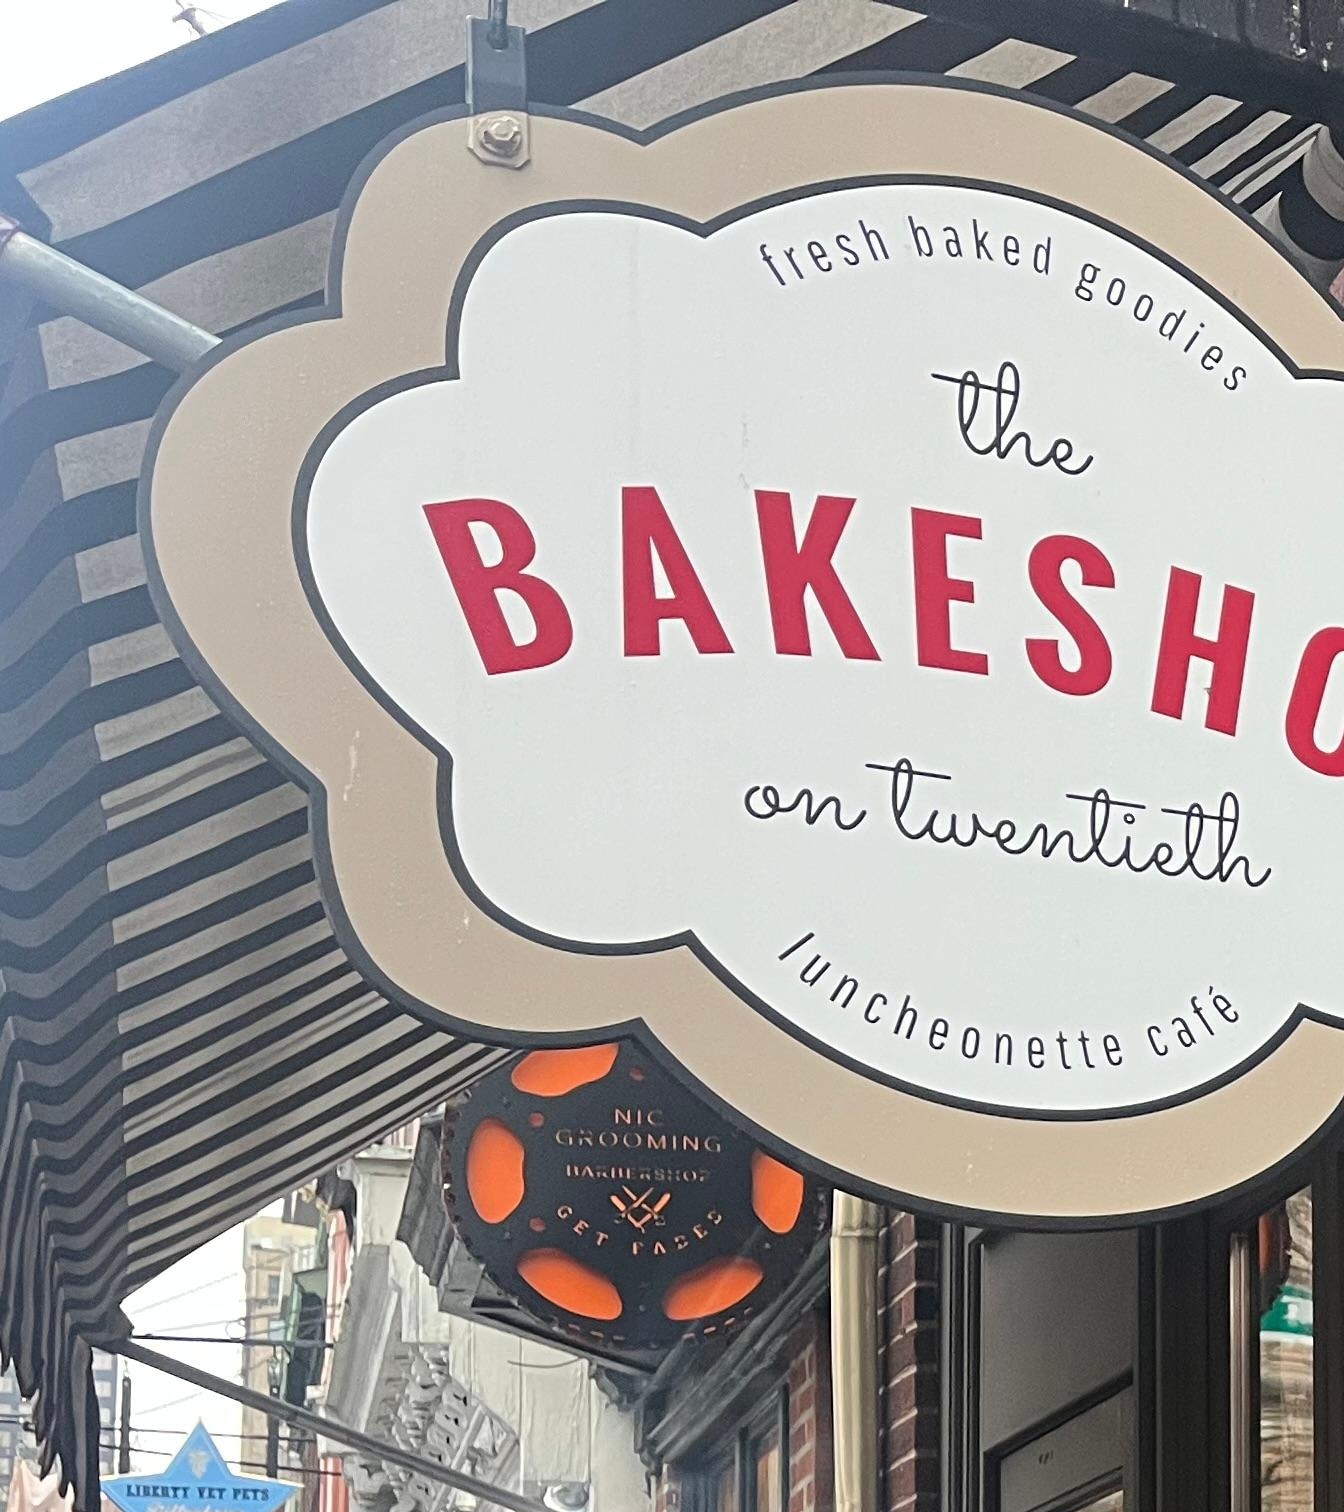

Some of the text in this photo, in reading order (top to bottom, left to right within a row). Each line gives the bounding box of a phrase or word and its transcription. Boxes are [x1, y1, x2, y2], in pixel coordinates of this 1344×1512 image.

[758, 214, 1248, 392] fresh baked goodies
[931, 360, 1095, 477] the
[743, 757, 1273, 889] on twentieth
[778, 930, 1242, 1071] luncheonette café
[613, 1107, 664, 1127] NIC
[555, 1127, 722, 1153] GROOMING
[565, 1162, 713, 1183] BARBERSHOP
[557, 1204, 609, 1247] GET
[126, 1483, 270, 1502] LIBERTY VET PETS
